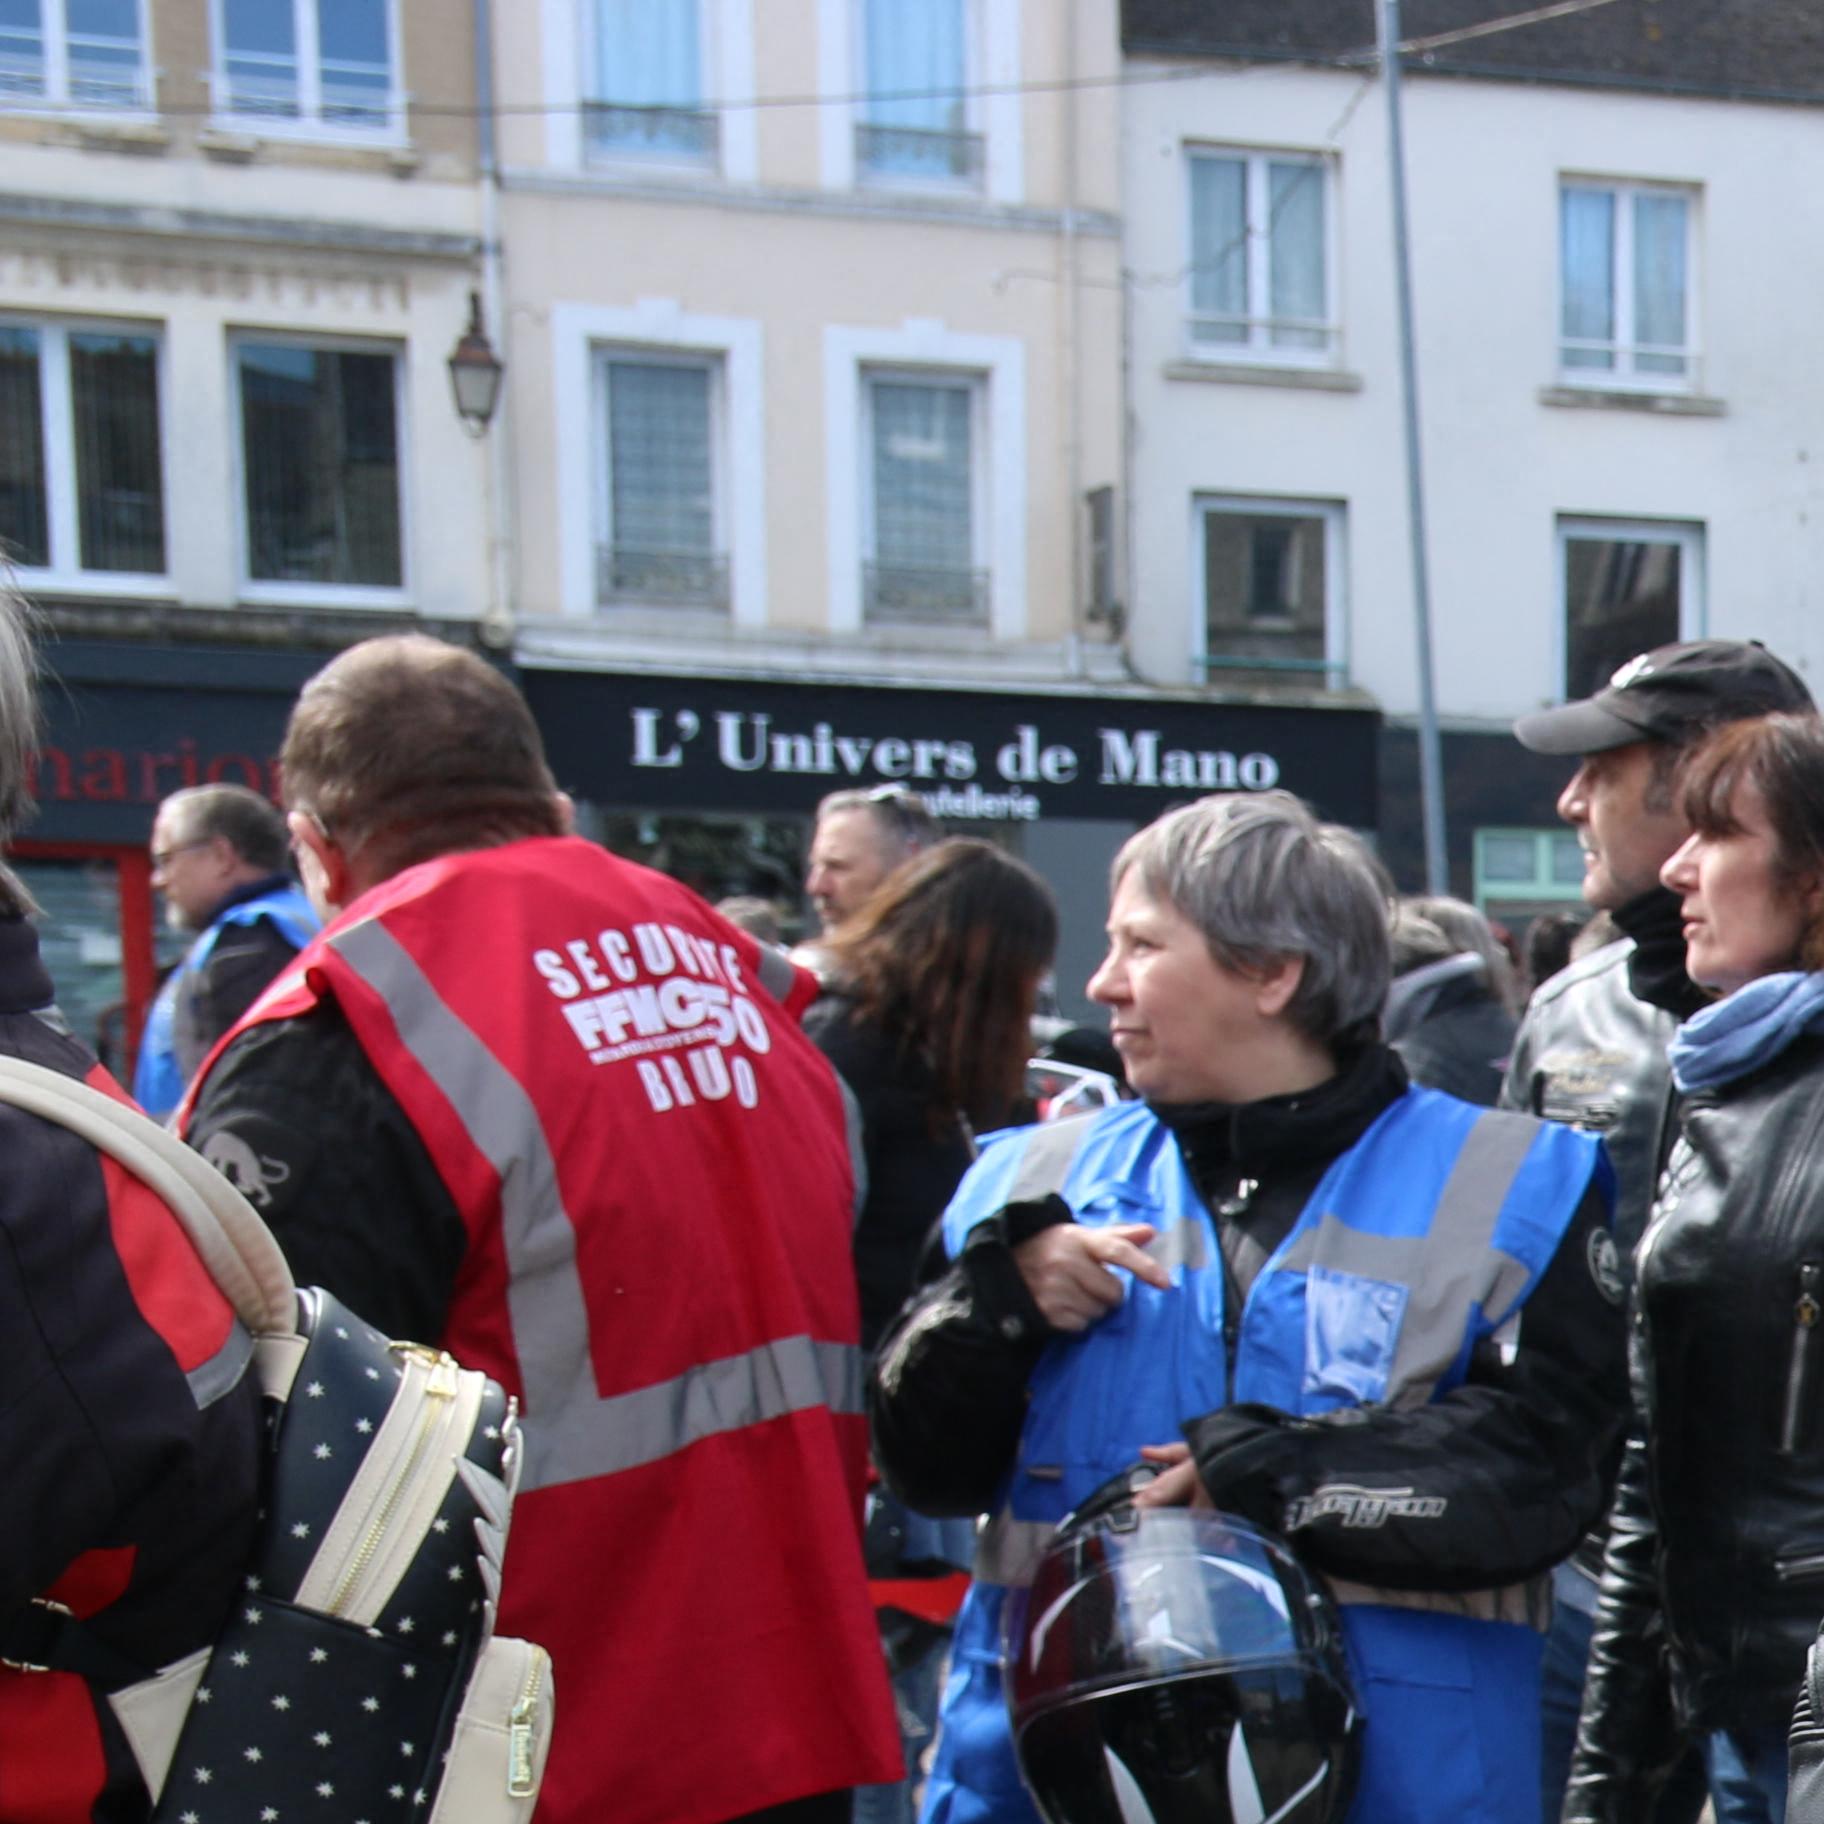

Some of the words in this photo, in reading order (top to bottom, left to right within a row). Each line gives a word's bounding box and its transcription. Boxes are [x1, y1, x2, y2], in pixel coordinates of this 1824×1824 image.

[716, 712, 976, 779] Univers
[998, 725, 1077, 784] de
[1099, 729, 1279, 790] Mano
